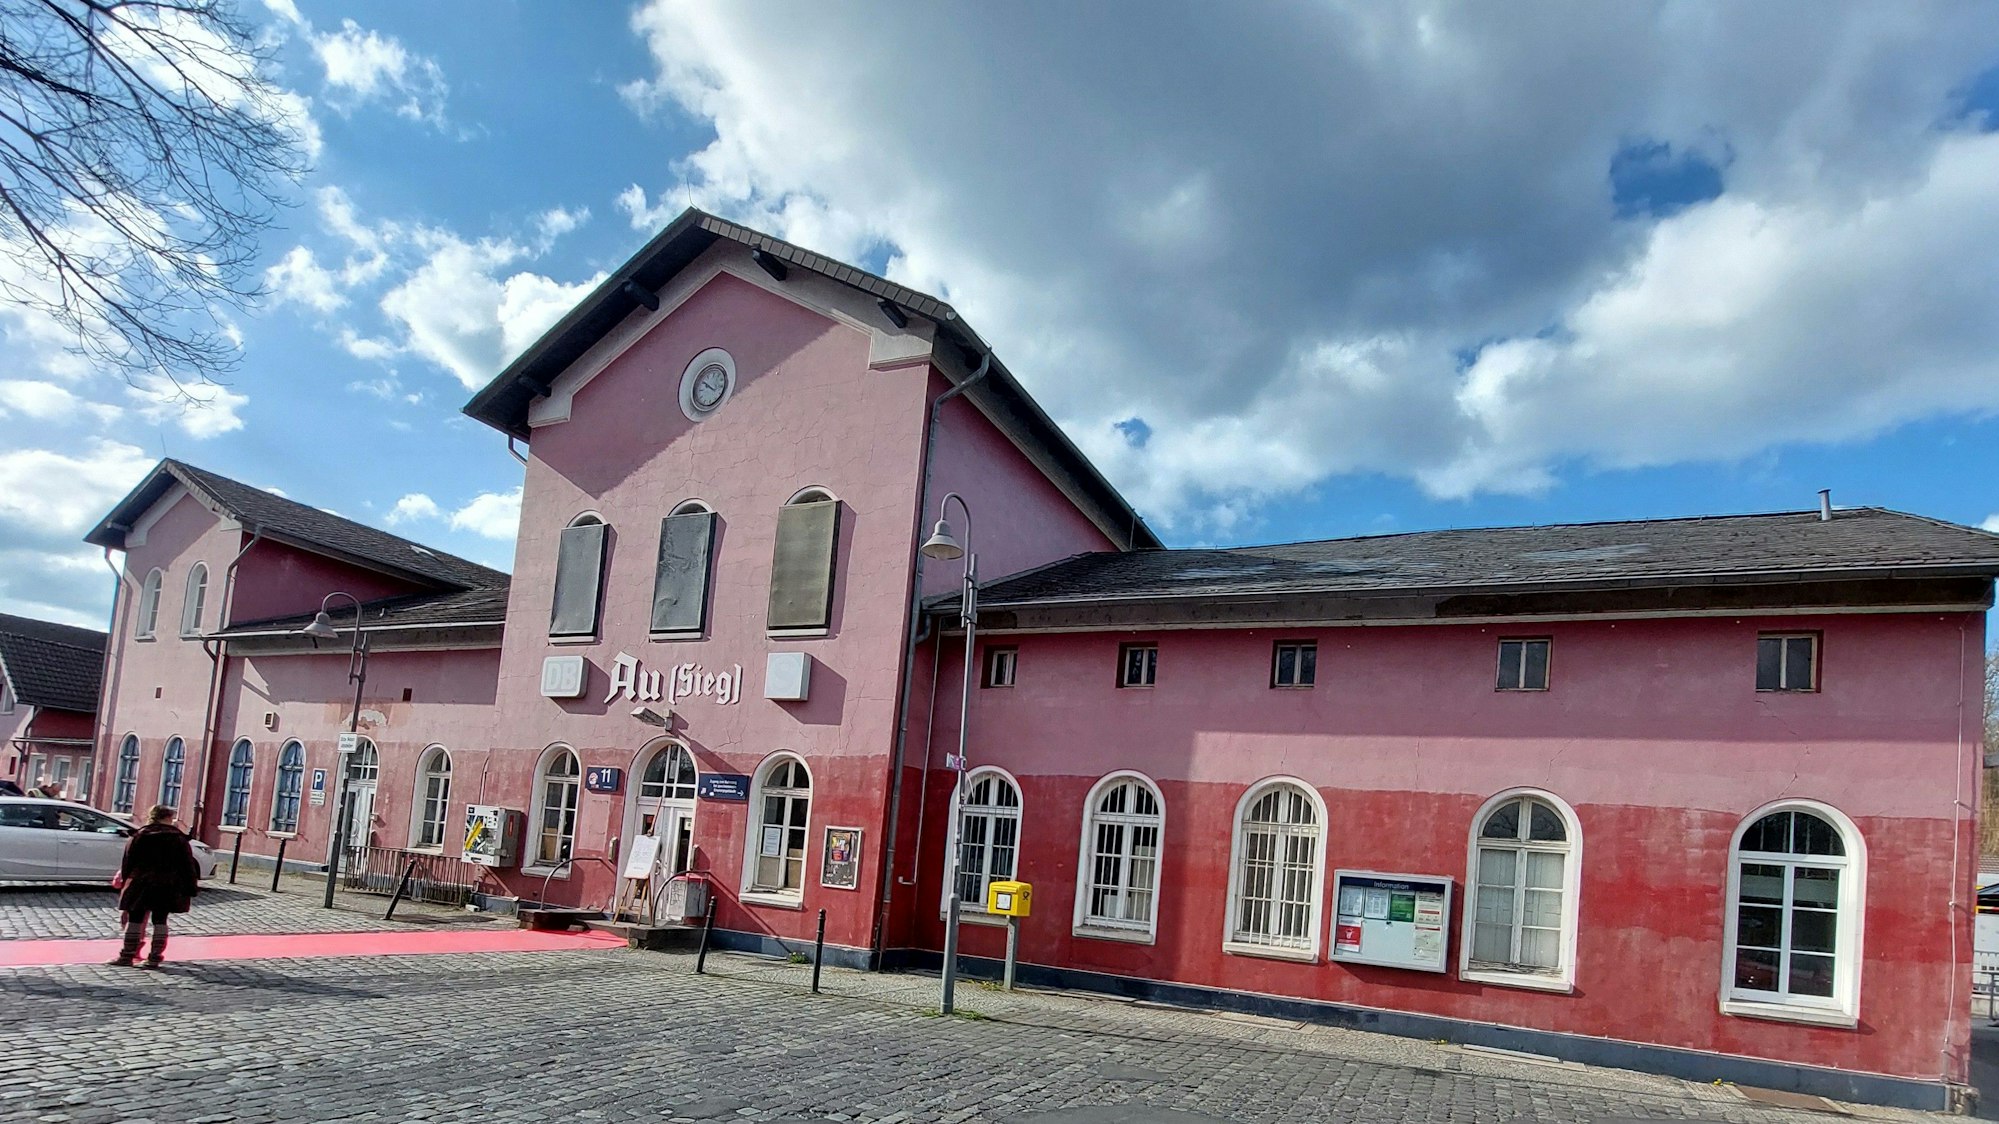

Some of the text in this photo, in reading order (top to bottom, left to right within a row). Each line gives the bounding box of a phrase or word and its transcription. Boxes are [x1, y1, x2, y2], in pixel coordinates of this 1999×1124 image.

[547, 661, 576, 690] DB
[603, 651, 743, 705] Au (Sieg)
[314, 771, 323, 788] P
[601, 768, 611, 783] 11
[1373, 881, 1409, 890] Information
